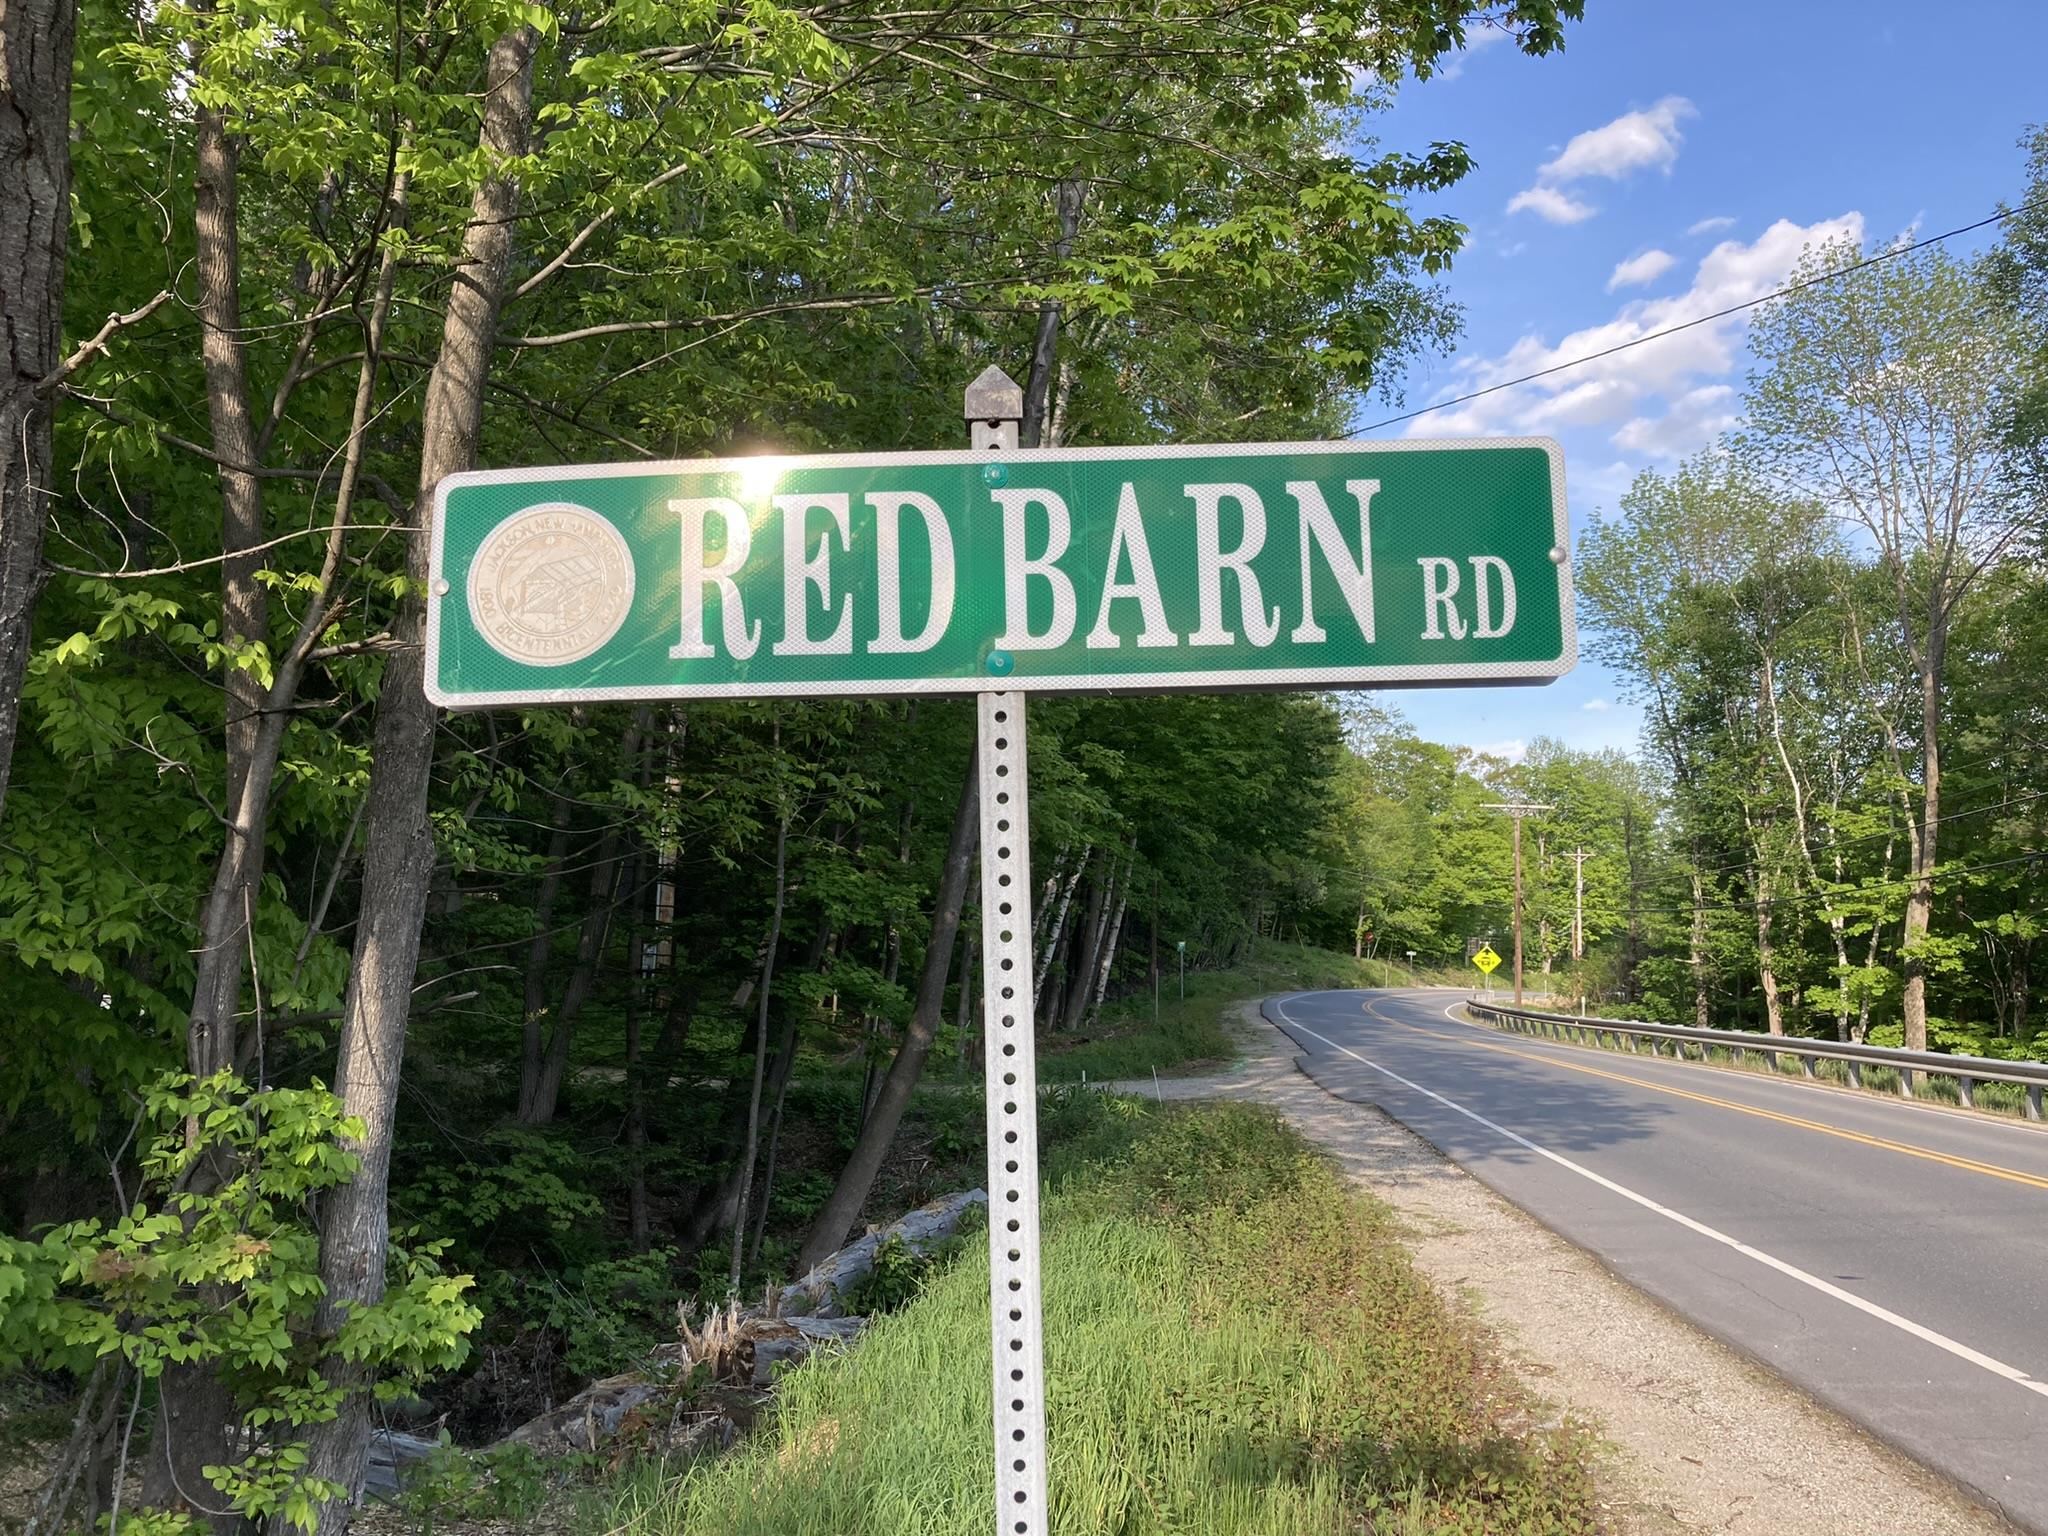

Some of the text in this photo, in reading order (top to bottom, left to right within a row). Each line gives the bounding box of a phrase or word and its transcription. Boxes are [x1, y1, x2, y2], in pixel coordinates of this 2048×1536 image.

[535, 517, 566, 534] NEW
[667, 477, 1517, 661] RED BARN RD
[479, 587, 497, 619] 1800
